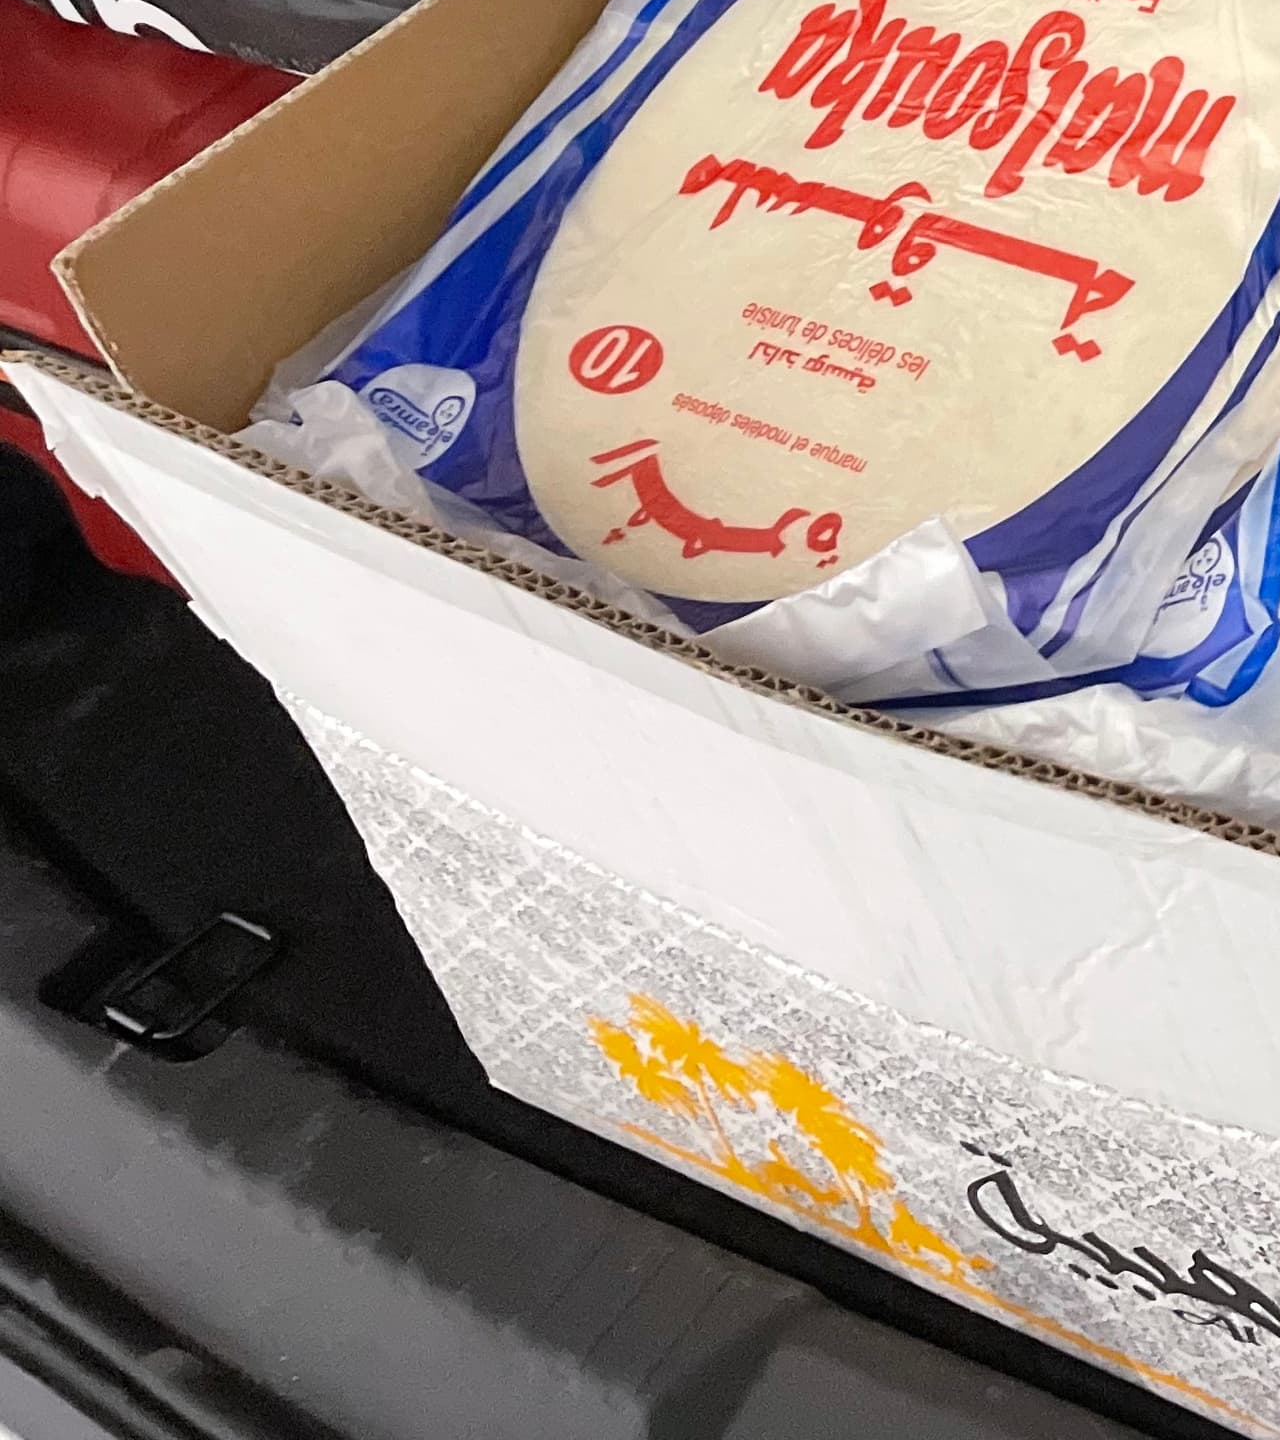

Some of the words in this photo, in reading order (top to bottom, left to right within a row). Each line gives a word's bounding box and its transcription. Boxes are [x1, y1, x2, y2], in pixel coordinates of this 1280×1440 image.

[678, 153, 1136, 363] ملسوقة
[741, 301, 801, 333] tunisie
[804, 321, 828, 344] de
[582, 331, 652, 389] 10
[831, 332, 897, 374] délices
[901, 352, 931, 378] les
[789, 430, 810, 452] et
[811, 436, 868, 475] marque
[1162, 539, 1226, 601] elgam
